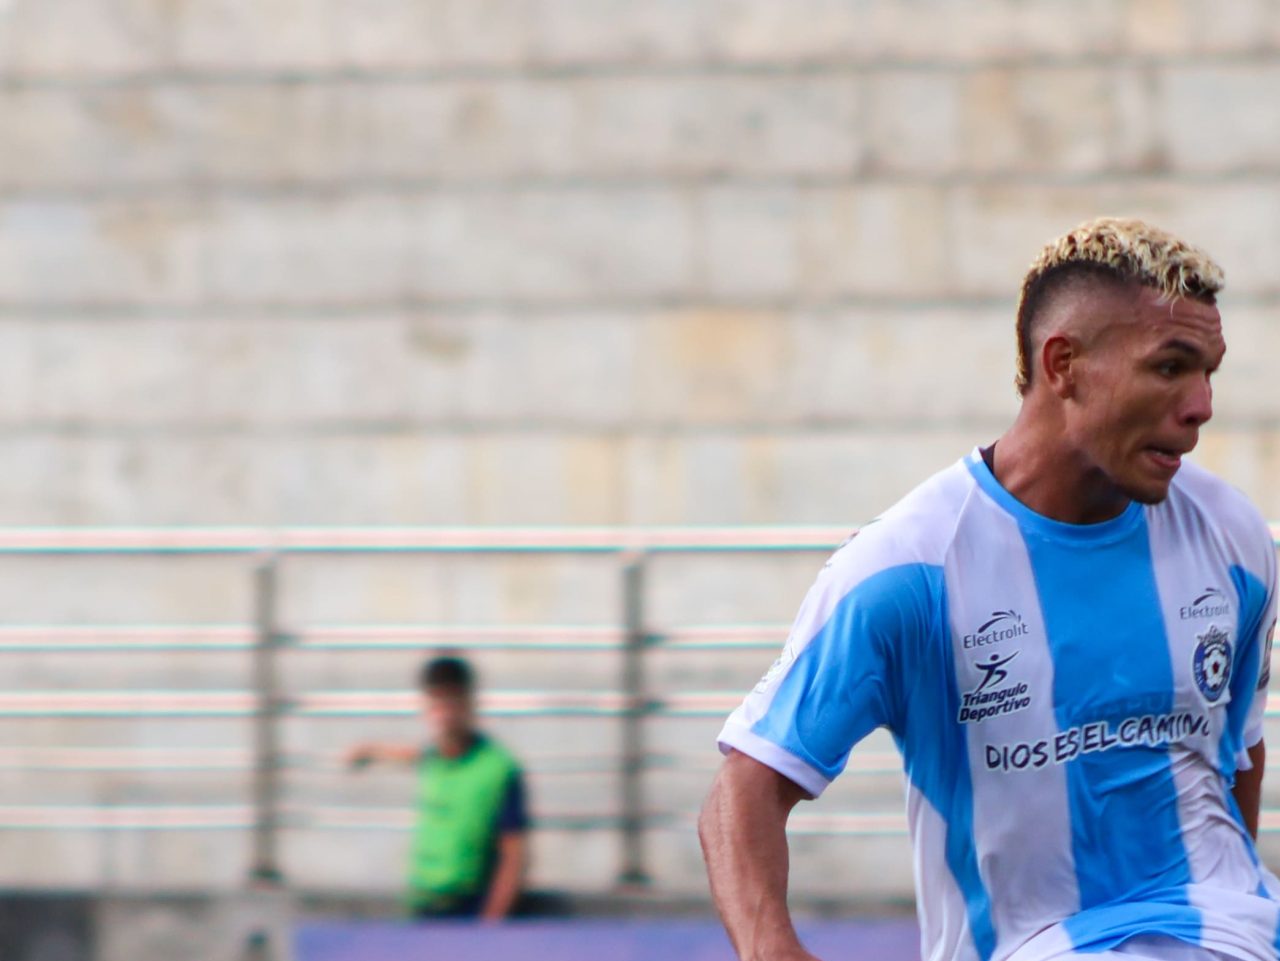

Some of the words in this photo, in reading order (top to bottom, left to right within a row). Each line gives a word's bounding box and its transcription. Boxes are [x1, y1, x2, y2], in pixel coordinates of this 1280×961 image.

[963, 623, 1028, 649] Electrolit
[963, 682, 1028, 706] Triangulo
[960, 697, 1031, 722] Deportivo
[986, 740, 1048, 770] DIOS
[1055, 730, 1079, 761] ES
[1082, 723, 1116, 751] EL
